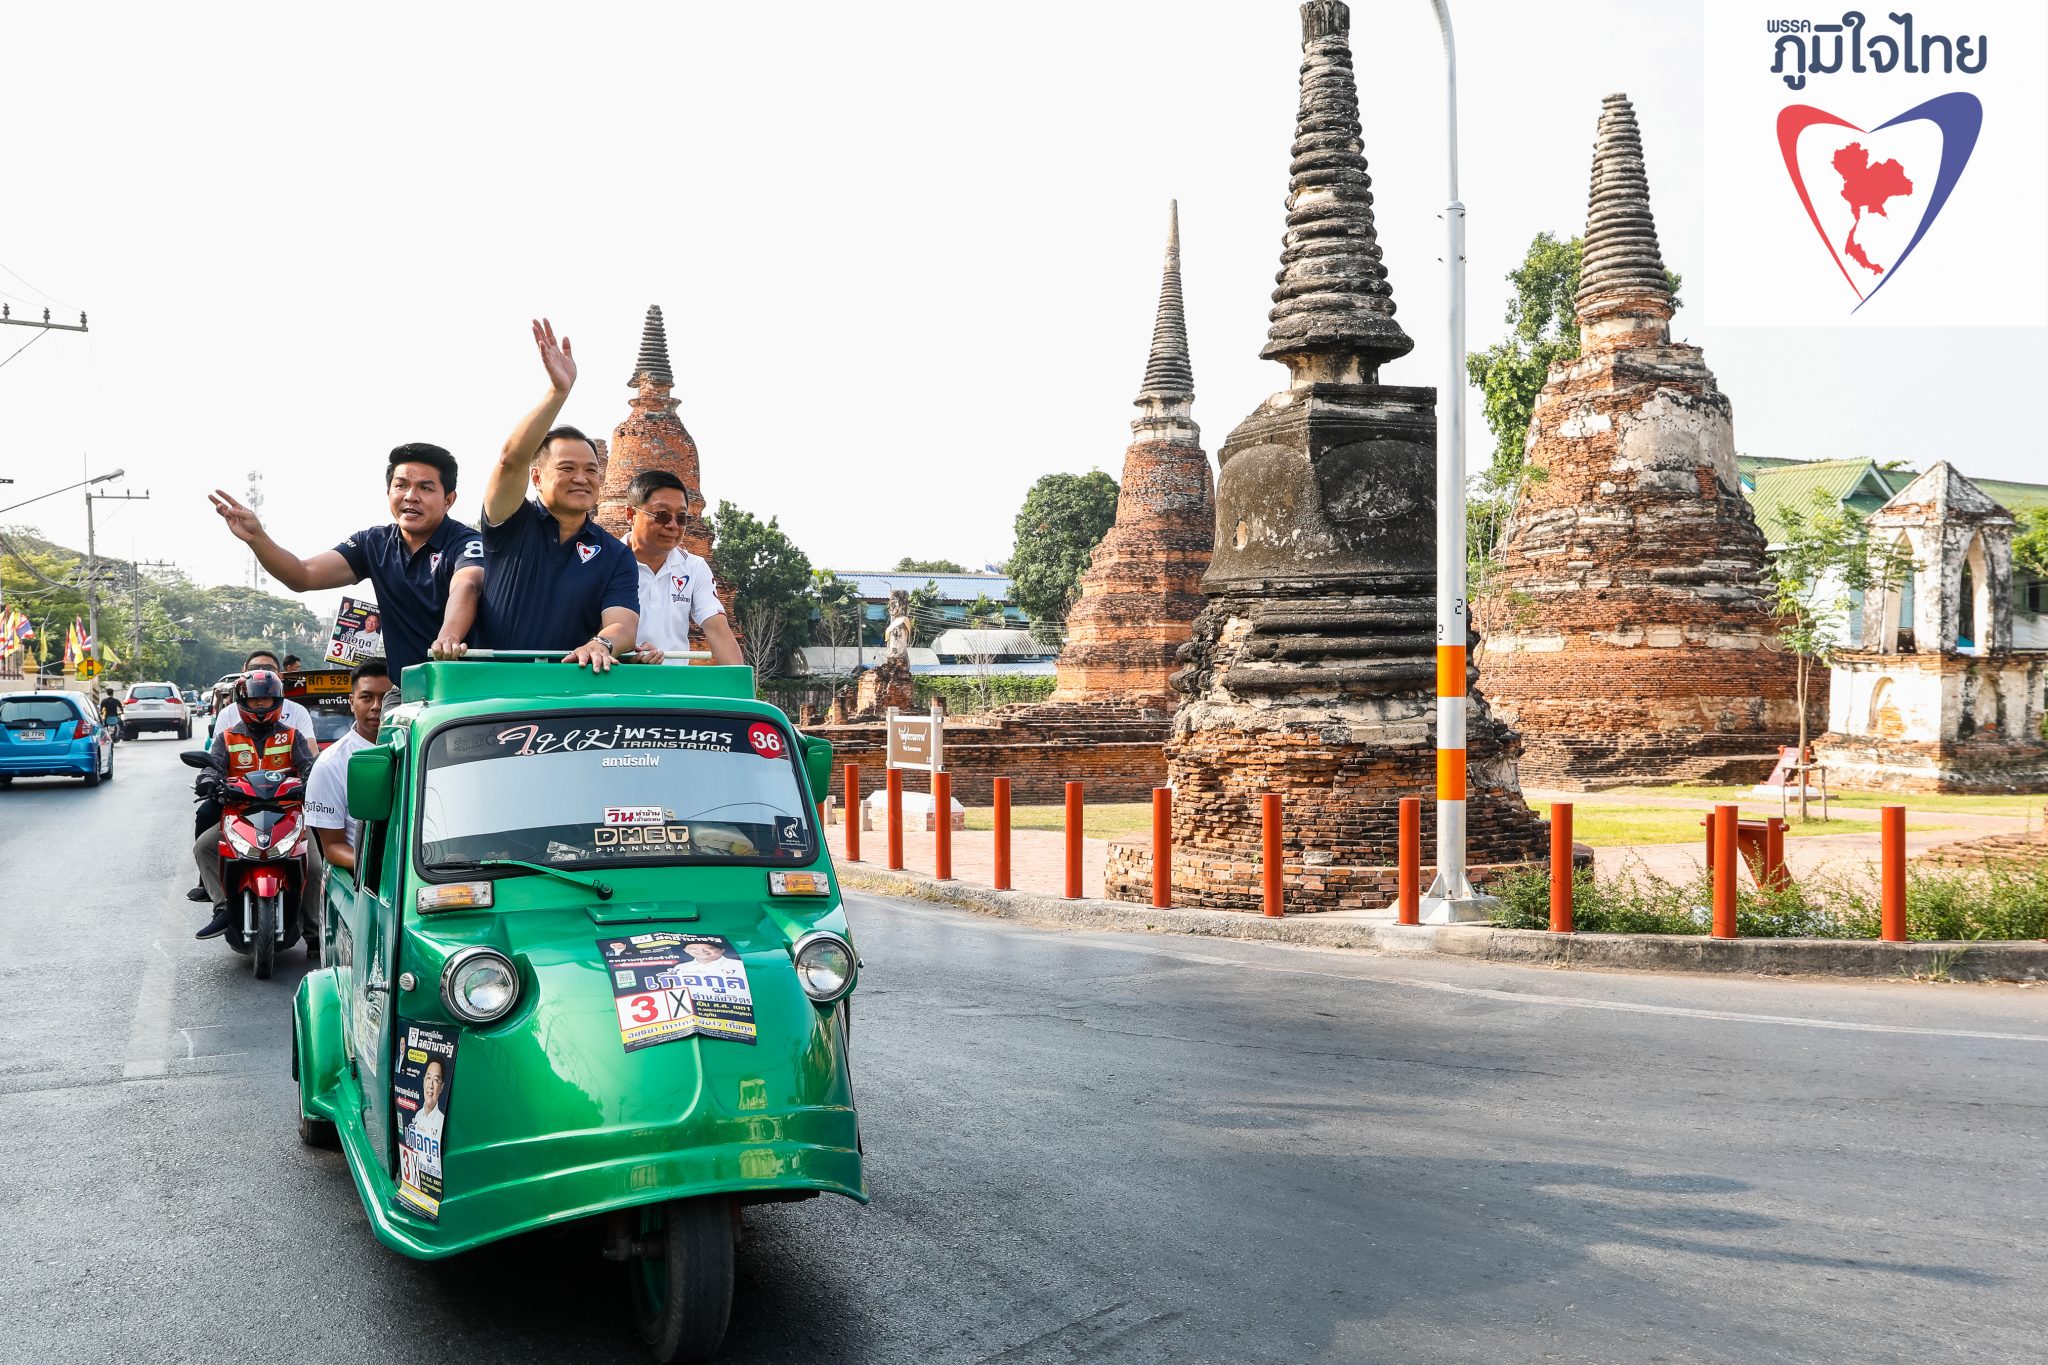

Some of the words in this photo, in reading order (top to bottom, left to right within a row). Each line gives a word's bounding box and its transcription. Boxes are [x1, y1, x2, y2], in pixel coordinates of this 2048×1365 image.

[1455, 598, 1463, 615] 2
[332, 643, 344, 657] 3
[330, 675, 349, 686] 529
[274, 733, 288, 745] 23
[624, 727, 733, 744] พระนคร
[752, 731, 780, 751] 36
[621, 740, 731, 753] TRAINSTATION
[601, 754, 660, 768] สถานีรถไฟ
[607, 809, 635, 823] วิน
[595, 844, 691, 853] PHANNARAI
[644, 968, 746, 994] เกื้อกูล
[630, 996, 659, 1023] 3
[417, 1037, 455, 1059] ลดอำนาจรัฐ
[404, 1117, 439, 1163] เกื้อกูล
[402, 1149, 410, 1180] 3
